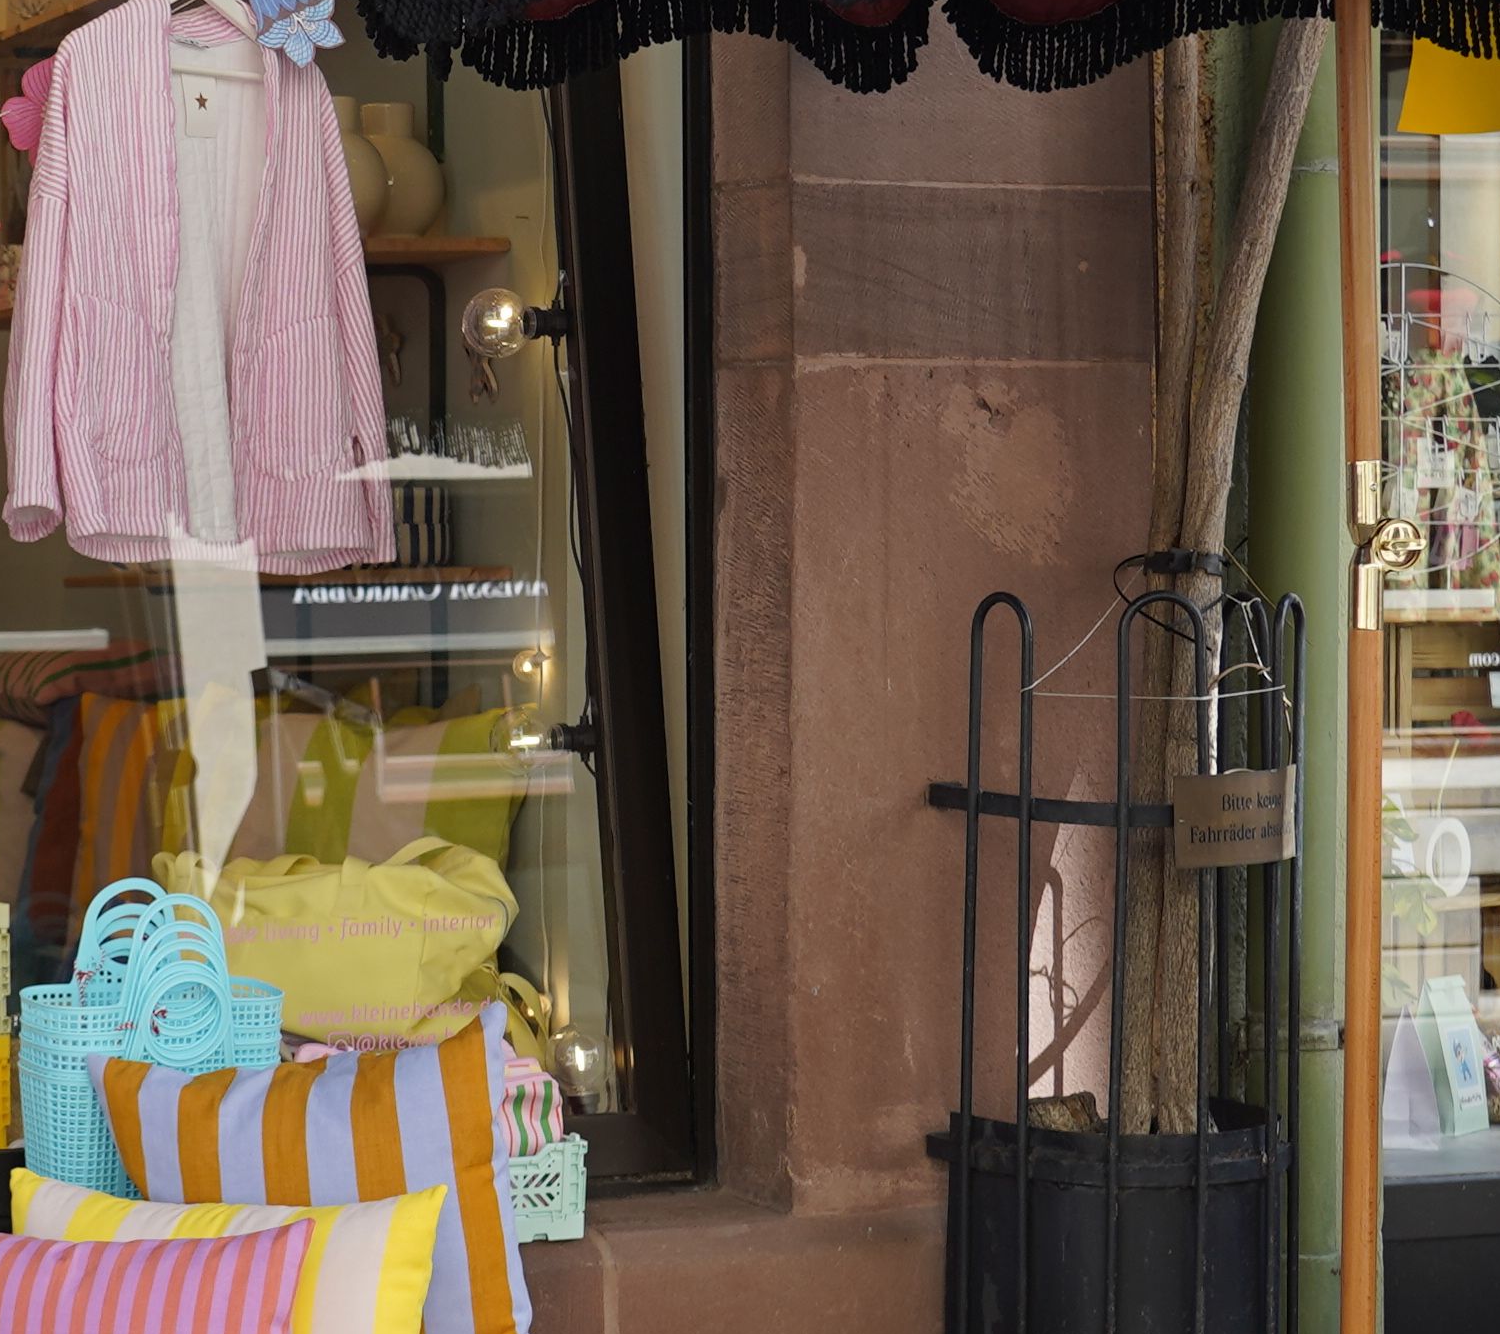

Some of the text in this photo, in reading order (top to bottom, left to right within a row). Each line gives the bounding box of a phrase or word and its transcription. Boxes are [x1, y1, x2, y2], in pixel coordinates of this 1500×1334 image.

[1222, 793, 1253, 811] Bitte
[1190, 822, 1257, 844] Fahrräder
[264, 920, 319, 943] living
[340, 914, 402, 940] family
[422, 913, 495, 933] interior
